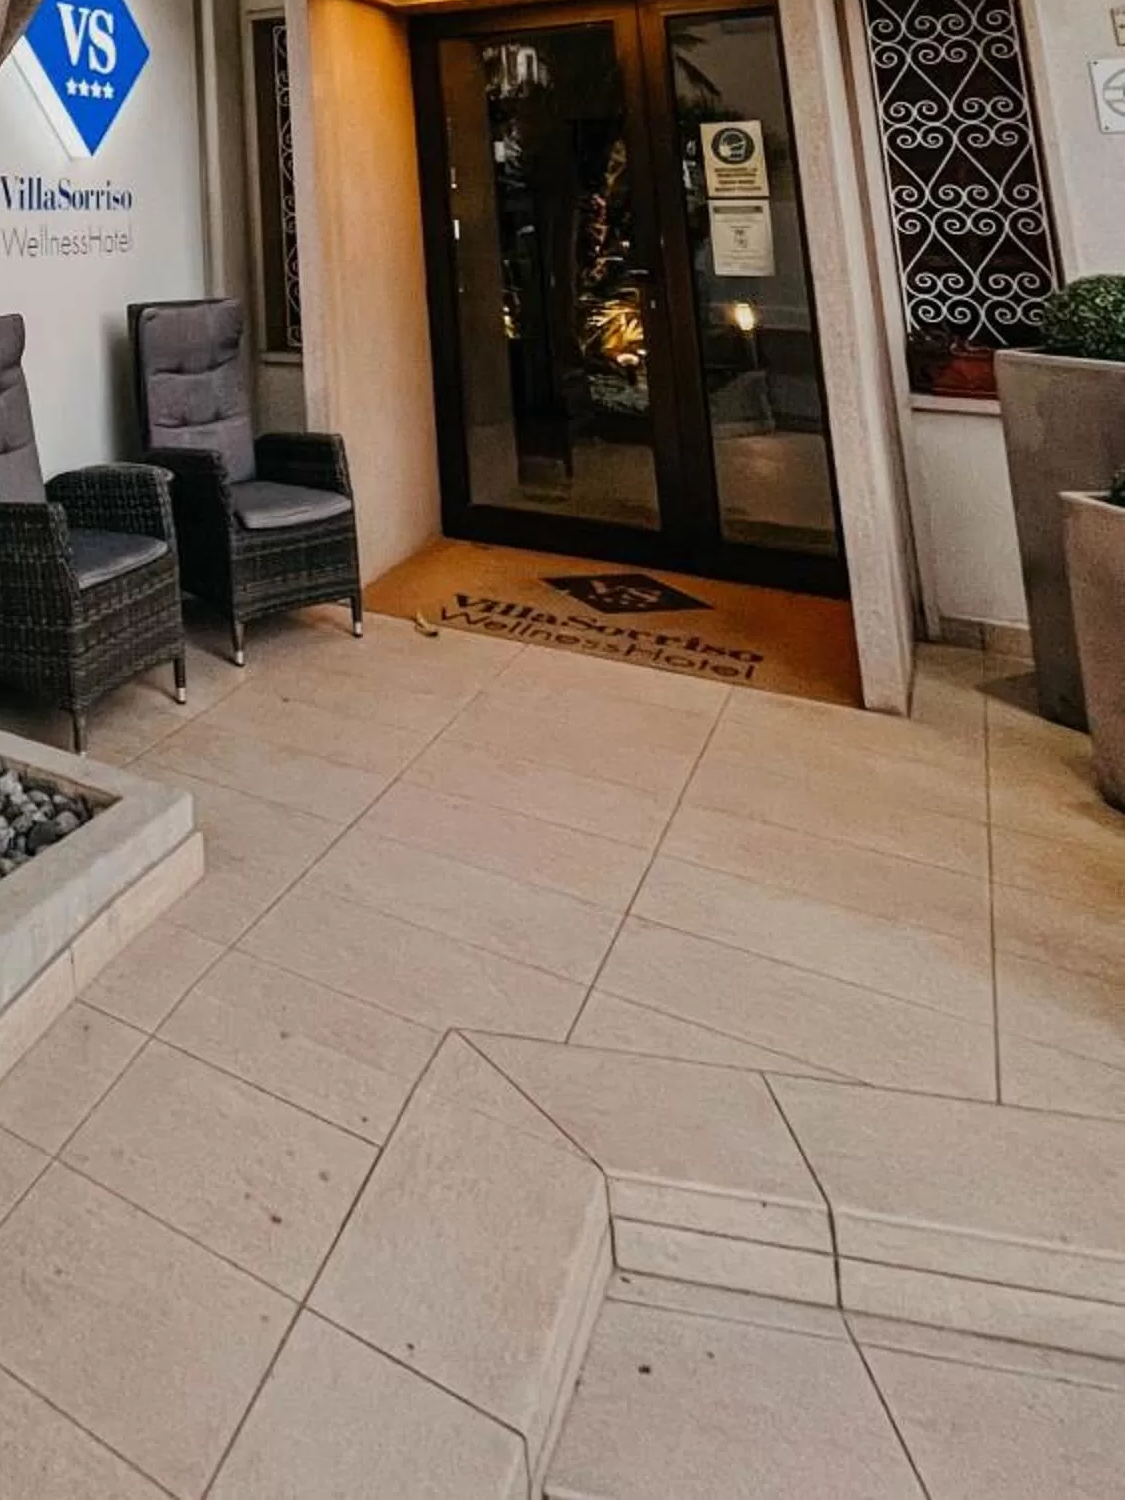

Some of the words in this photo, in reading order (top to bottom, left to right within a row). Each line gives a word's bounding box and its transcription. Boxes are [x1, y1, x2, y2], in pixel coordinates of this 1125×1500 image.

[56, 2, 117, 75] VS
[0, 175, 133, 211] VillaSorriso
[0, 223, 134, 258] WellnessHotel
[441, 606, 756, 680] WellnessHotel
[455, 593, 764, 663] VillaSorriso
